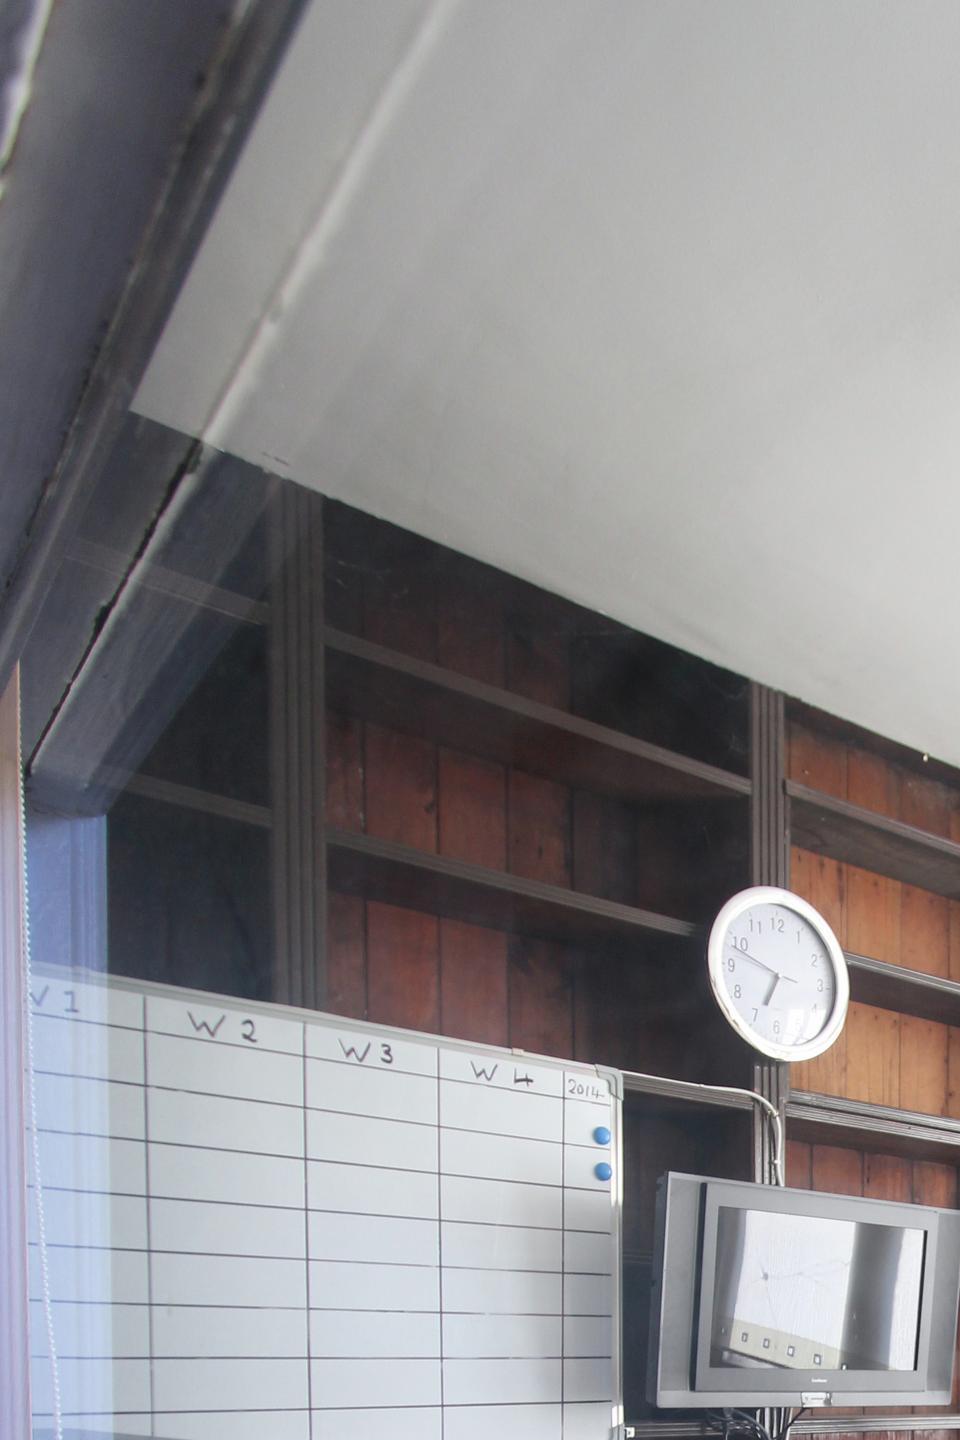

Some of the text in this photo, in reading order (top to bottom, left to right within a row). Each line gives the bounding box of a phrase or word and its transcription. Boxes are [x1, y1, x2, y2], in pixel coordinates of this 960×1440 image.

[749, 919, 762, 934] 11
[771, 917, 785, 933] 12
[732, 935, 749, 952] 10
[567, 1079, 606, 1098] 2014
